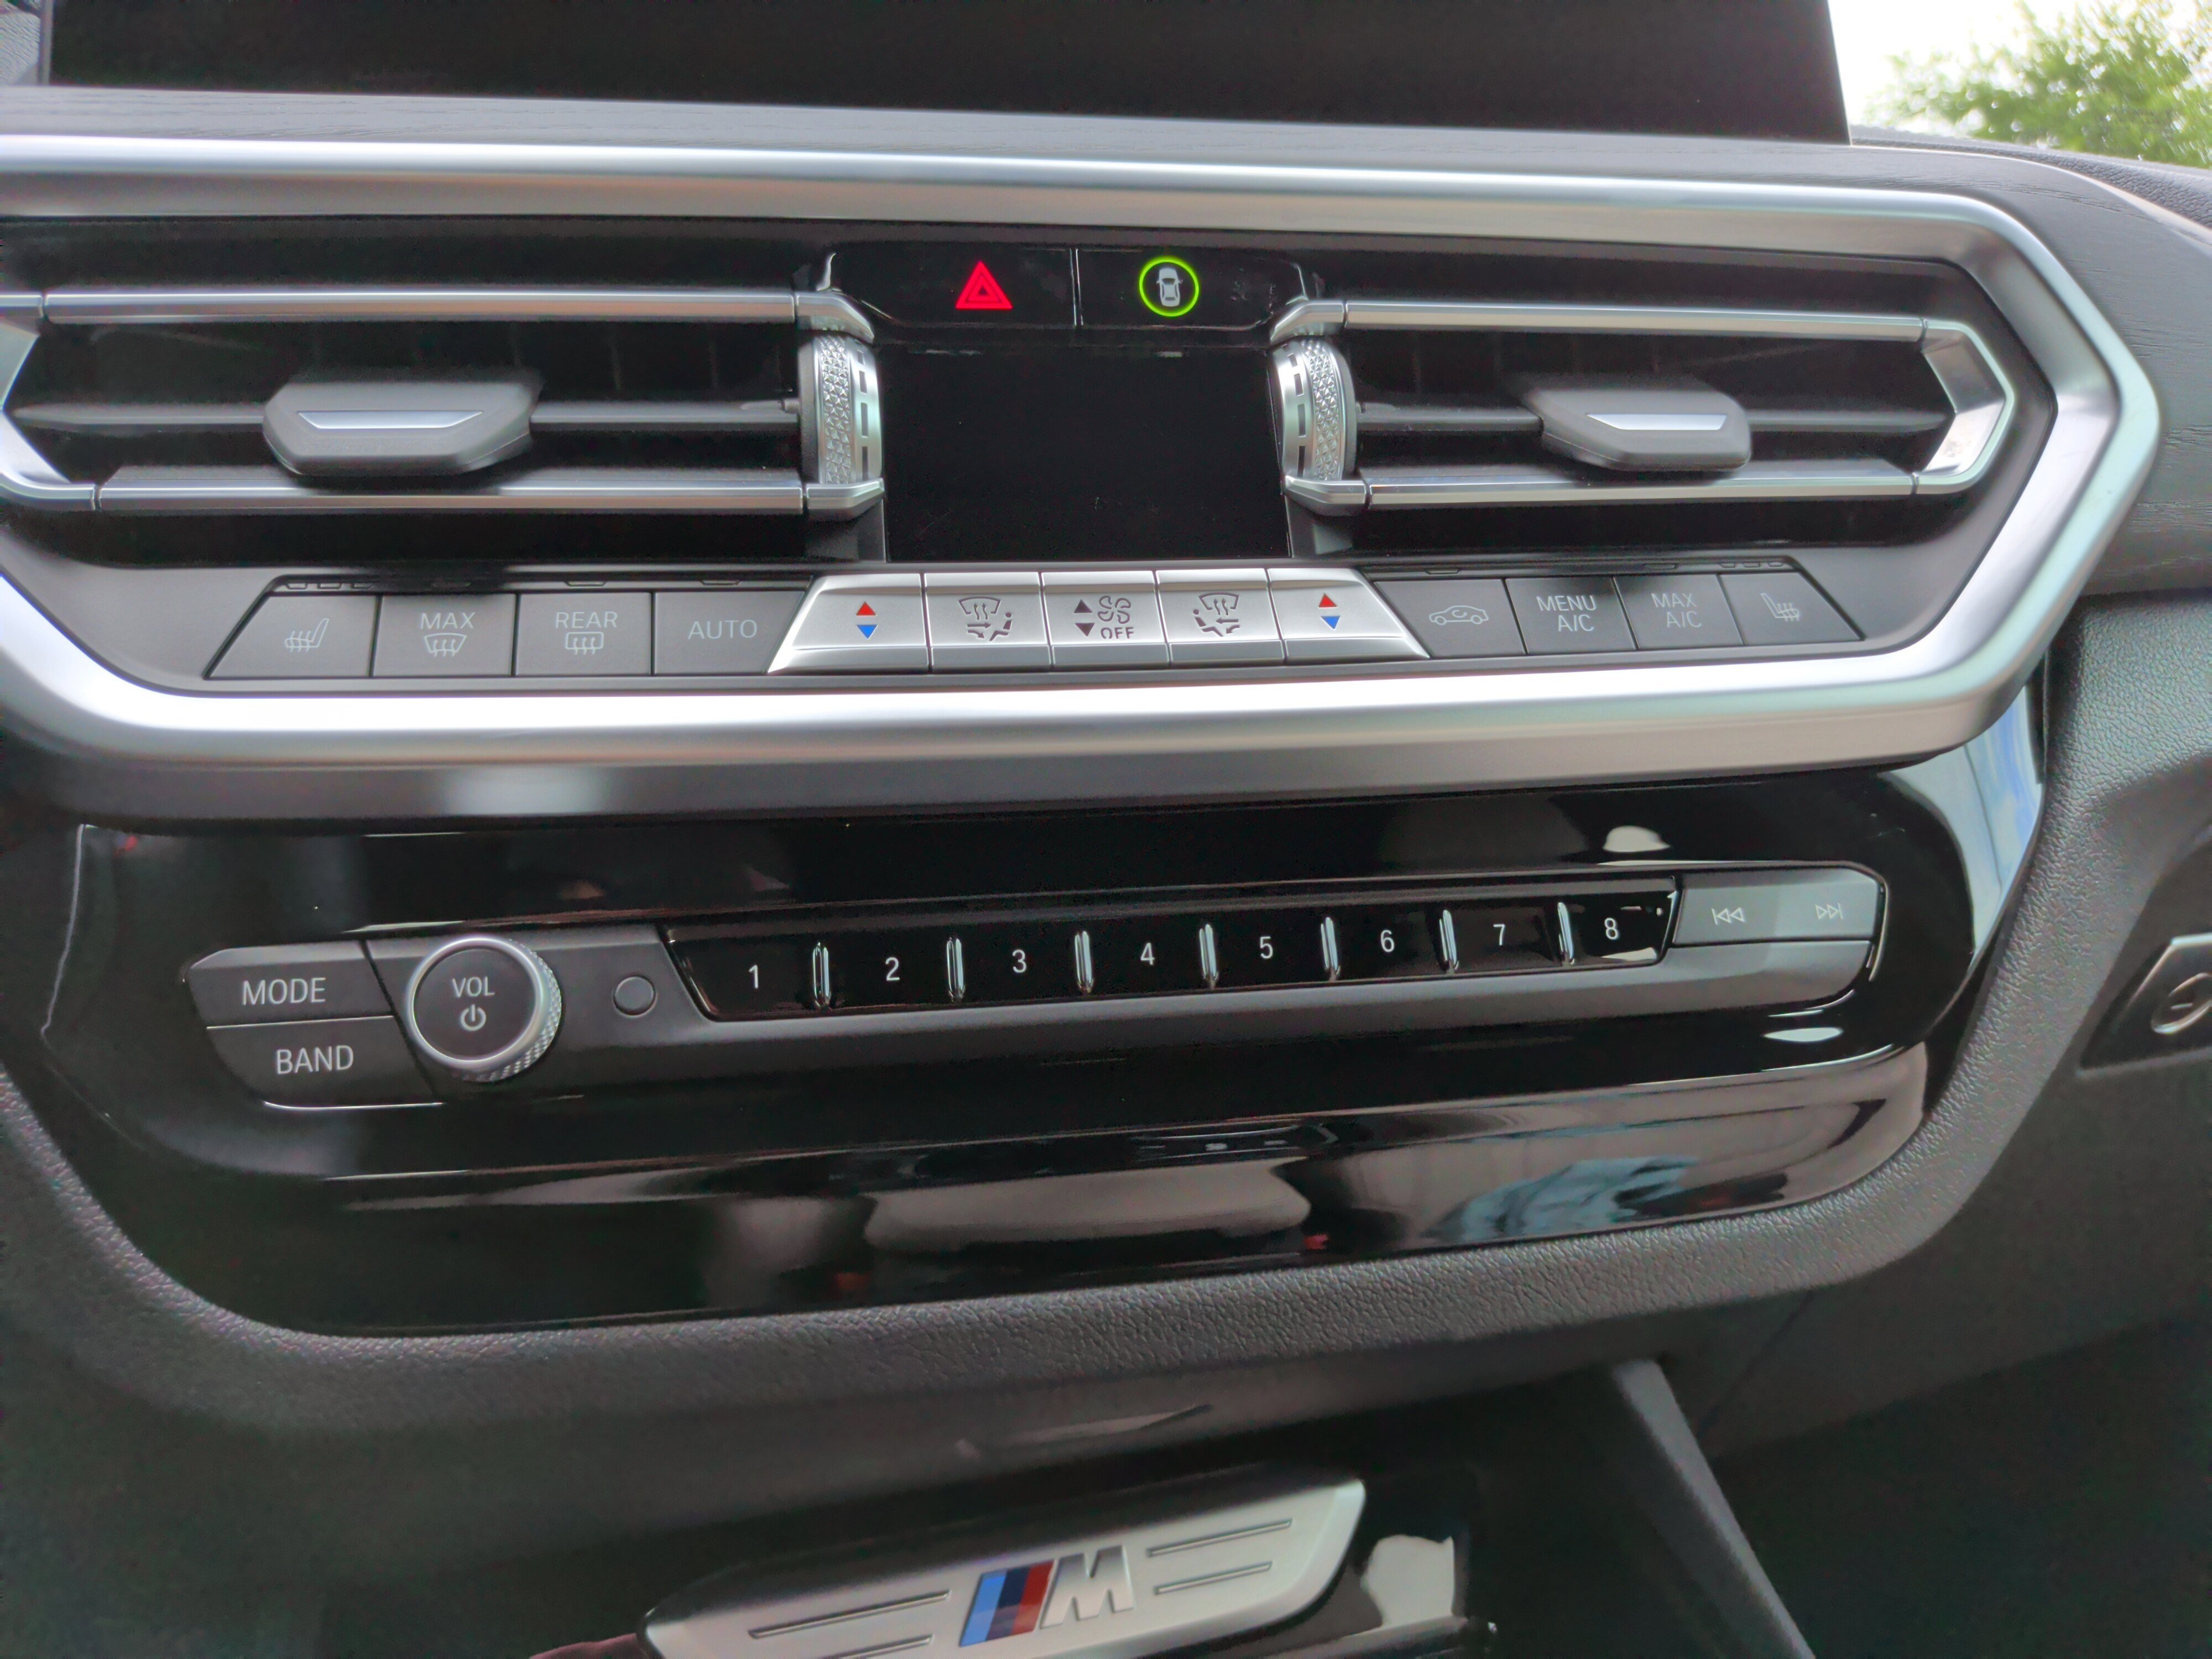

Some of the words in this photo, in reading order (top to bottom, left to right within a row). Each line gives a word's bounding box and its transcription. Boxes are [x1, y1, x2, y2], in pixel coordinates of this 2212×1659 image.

[1536, 594, 1596, 612] MENU
[1651, 592, 1698, 609] MAX
[420, 612, 476, 629] MAX
[556, 611, 617, 629] REAR
[688, 620, 758, 639] AUTO
[1557, 614, 1594, 633] A/C
[1666, 612, 1702, 629] A/C
[1100, 627, 1134, 640] OFF
[1493, 924, 1506, 947] 7
[1604, 918, 1619, 941] 8
[1259, 936, 1274, 959] 5
[1379, 930, 1395, 953] 6
[1011, 949, 1027, 974] 3
[1140, 942, 1155, 966] 4
[748, 964, 760, 989] 1
[885, 957, 900, 982] 2
[242, 977, 326, 1006] MODE
[452, 976, 495, 997] VOL
[275, 1045, 354, 1076] BAND
[1039, 1545, 1136, 1629] M
